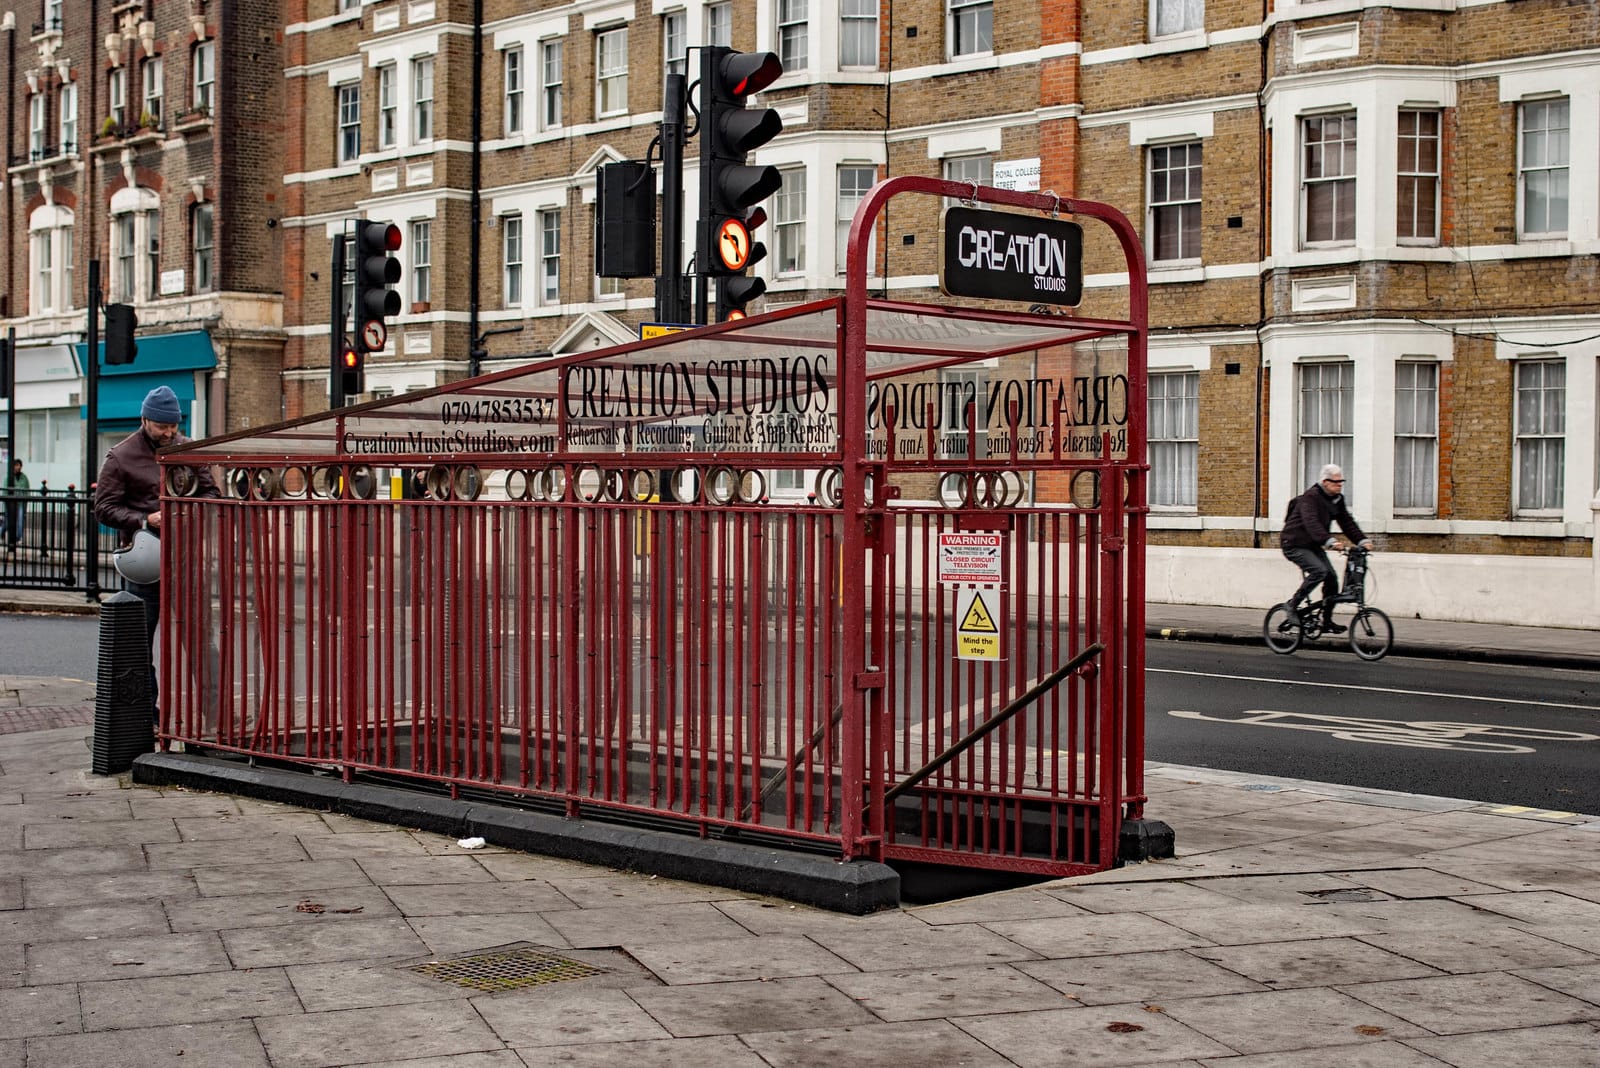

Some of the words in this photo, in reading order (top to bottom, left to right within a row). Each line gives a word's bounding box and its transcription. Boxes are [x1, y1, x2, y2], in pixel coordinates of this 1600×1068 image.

[995, 169, 1013, 179] ROYAL
[1034, 275, 1066, 292] STUDIOS
[564, 361, 698, 419] CREATION
[705, 354, 830, 417] STUDIOS
[441, 398, 555, 425] 07947853537
[343, 429, 555, 455] CreationMusicStudios.com
[565, 420, 620, 446] Rehearsals
[623, 420, 633, 446] &
[636, 419, 692, 452] Recording
[702, 417, 741, 444] Guitar
[743, 416, 755, 444] &
[757, 417, 786, 452] Amp
[790, 417, 833, 452] Repair
[945, 535, 997, 545] WARNING
[963, 637, 981, 645] Mind
[970, 647, 985, 655] step
